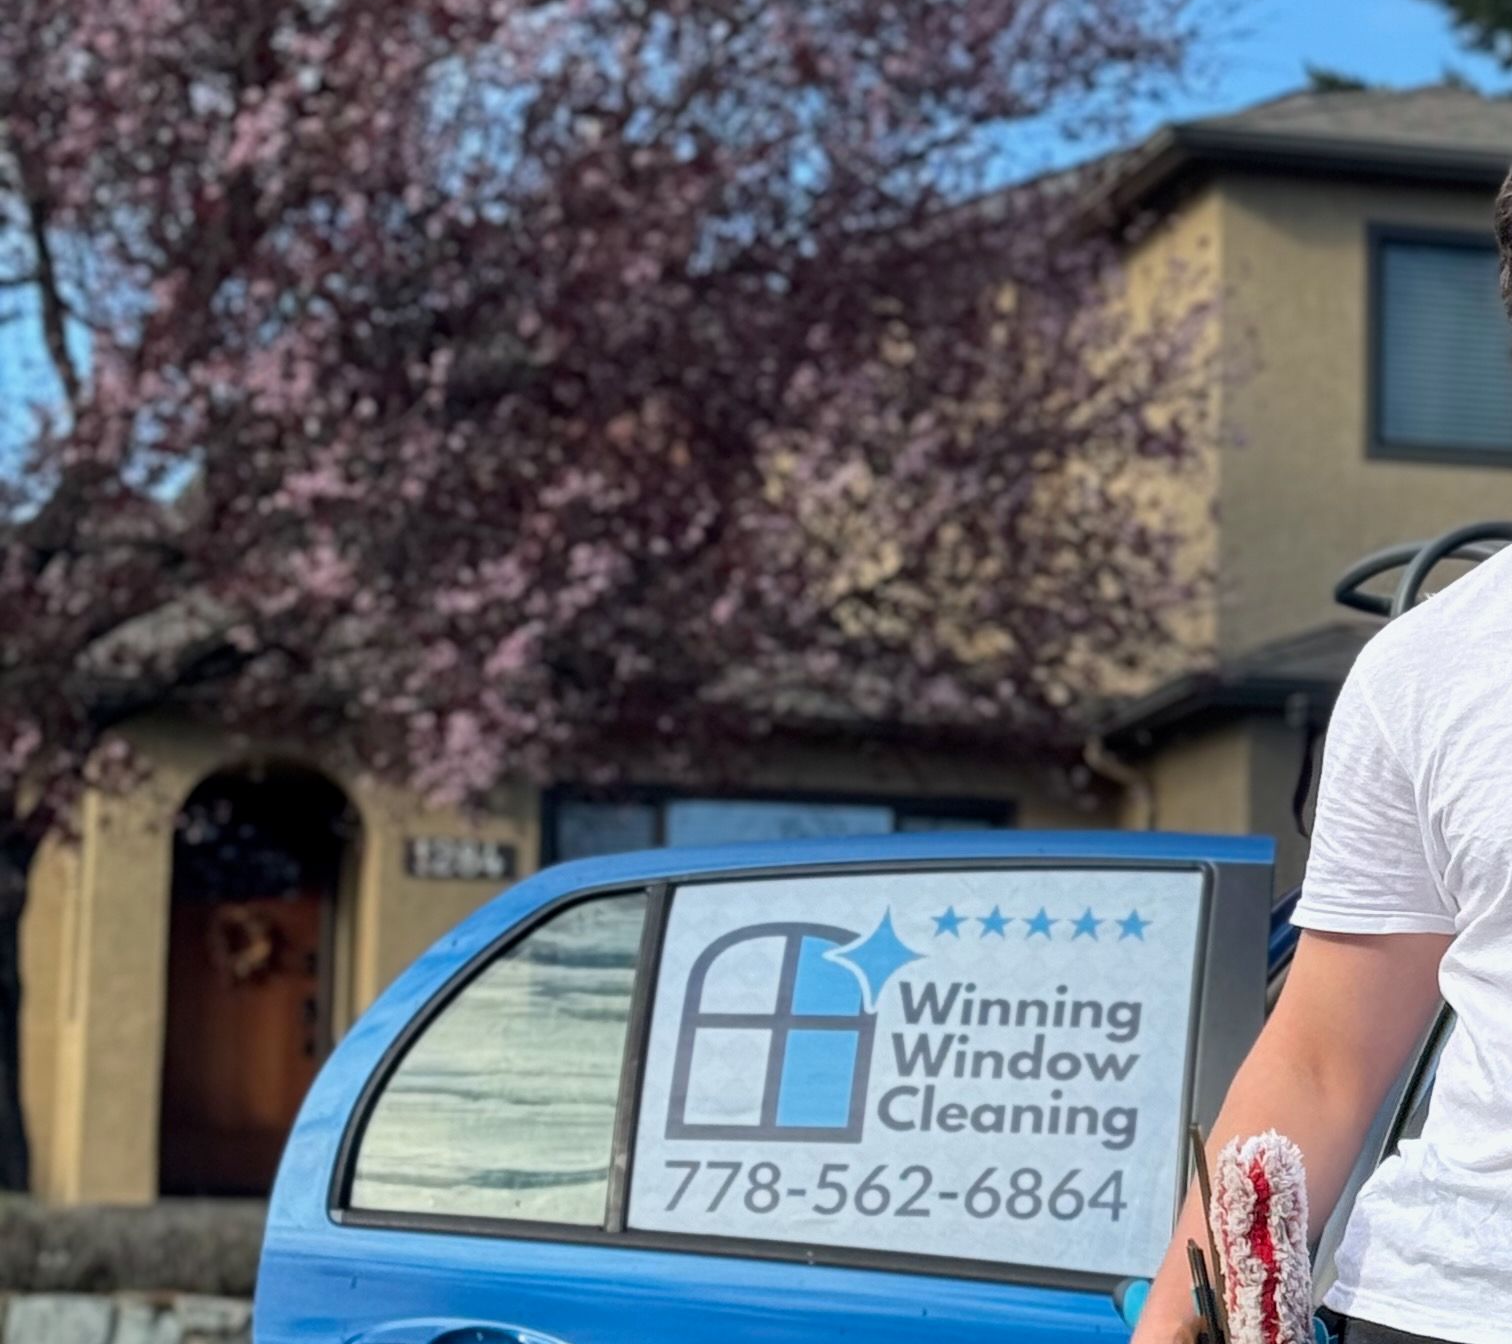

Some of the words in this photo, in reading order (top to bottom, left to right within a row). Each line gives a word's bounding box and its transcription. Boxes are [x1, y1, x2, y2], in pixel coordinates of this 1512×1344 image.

[899, 981, 1143, 1043] Winning
[892, 1032, 1140, 1081] Window
[877, 1085, 1139, 1150] Cleaning
[663, 1159, 1127, 1223] 778-562-6864
